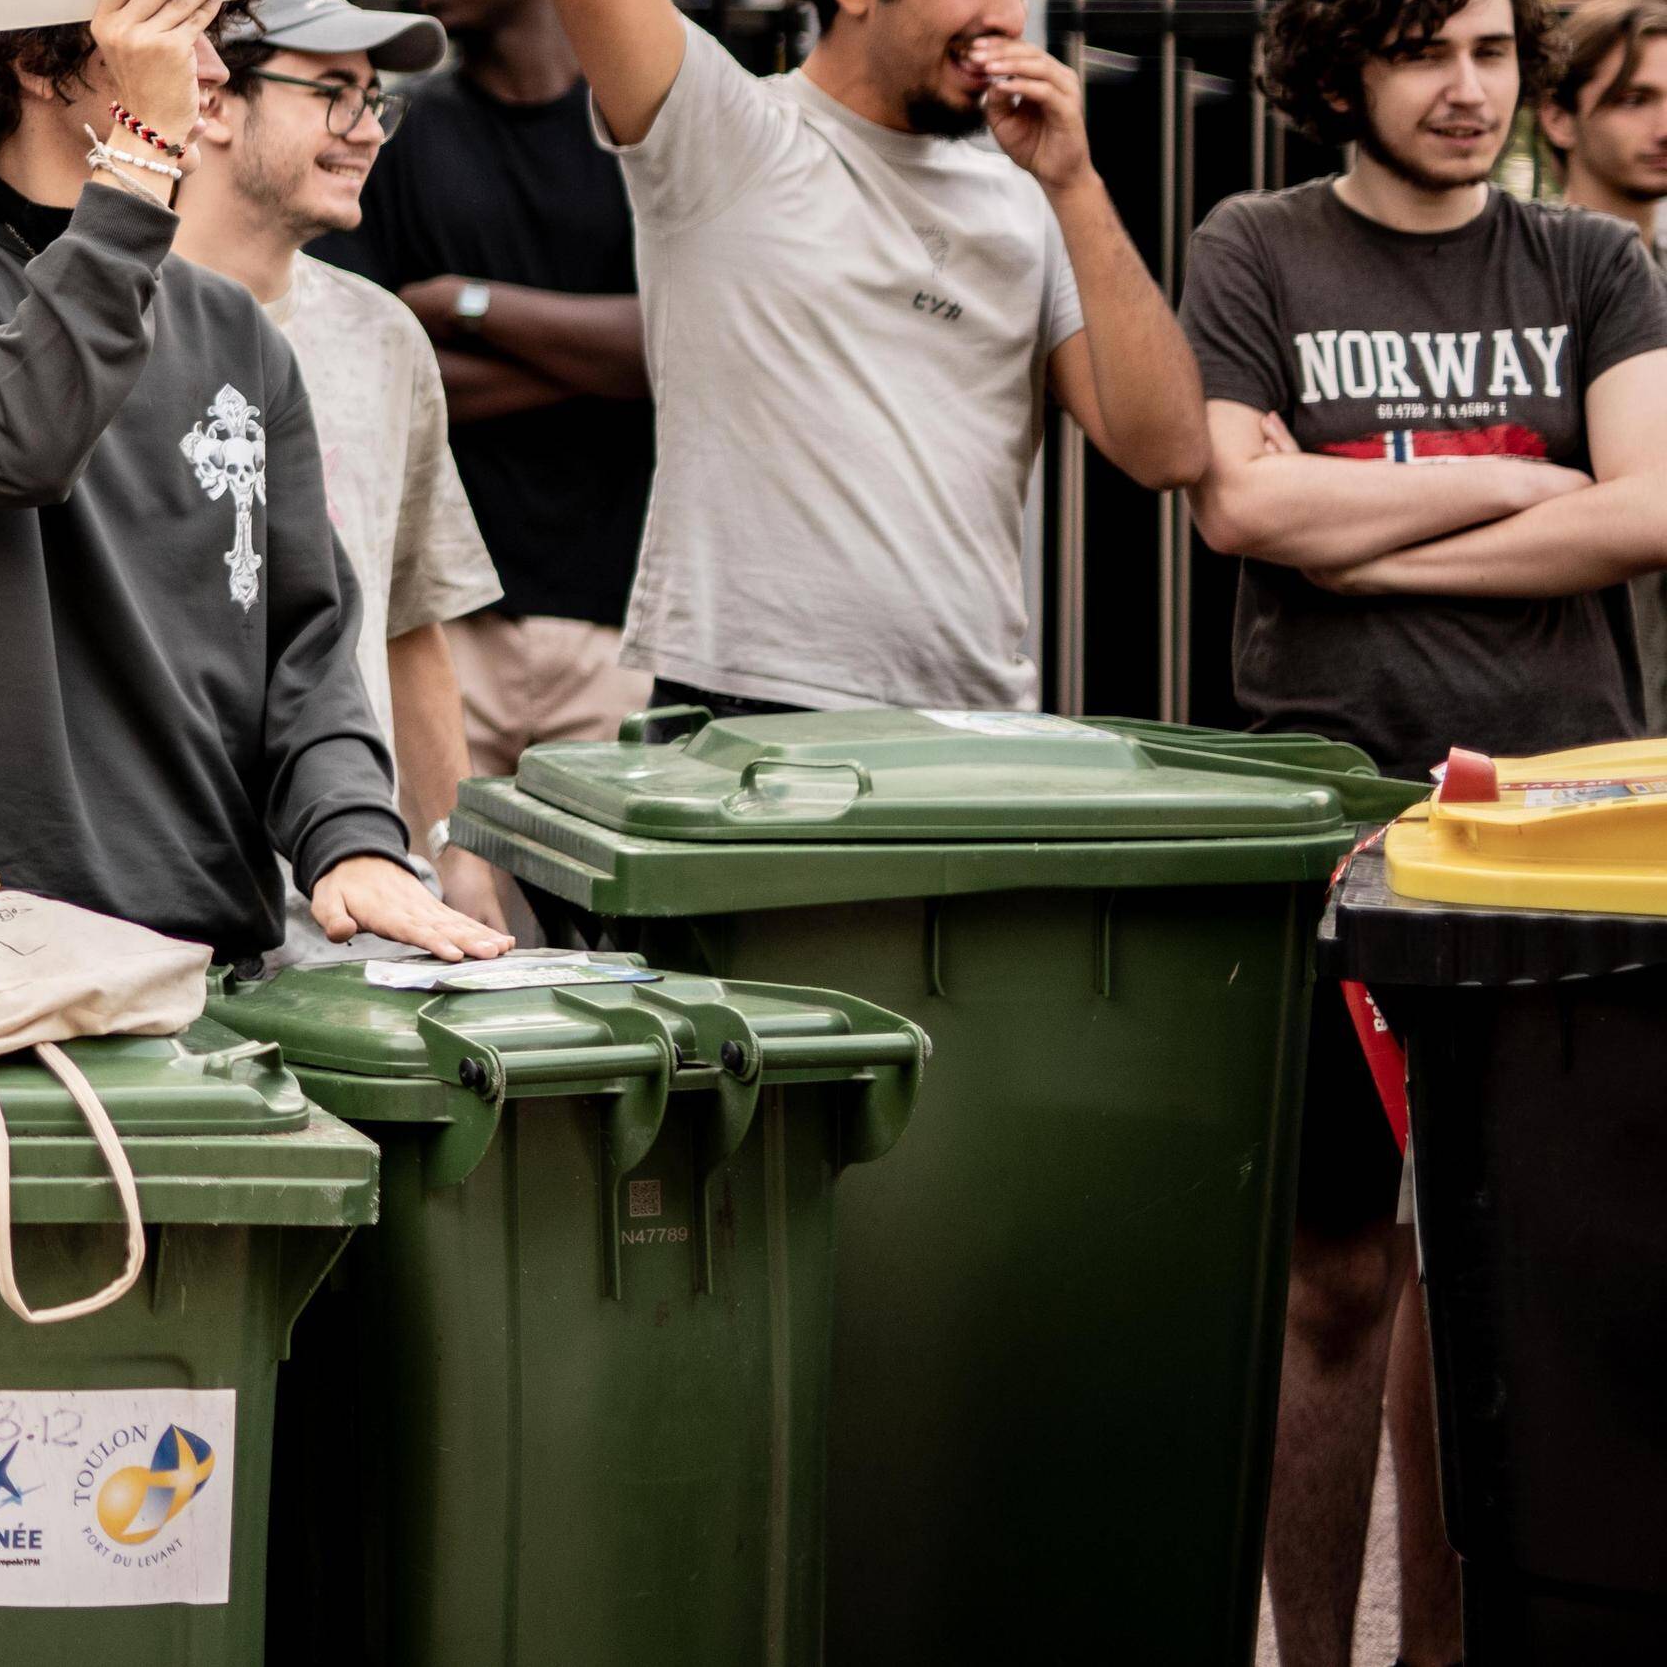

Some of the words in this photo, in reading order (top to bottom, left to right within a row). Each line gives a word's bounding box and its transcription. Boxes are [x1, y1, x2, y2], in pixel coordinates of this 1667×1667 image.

[1294, 324, 1569, 400] NORWAY
[620, 1226, 688, 1246] N47789
[73, 1422, 152, 1507] TOULON
[82, 1525, 111, 1559] PORT
[112, 1551, 133, 1568] DU
[136, 1537, 185, 1569] LEVANT
